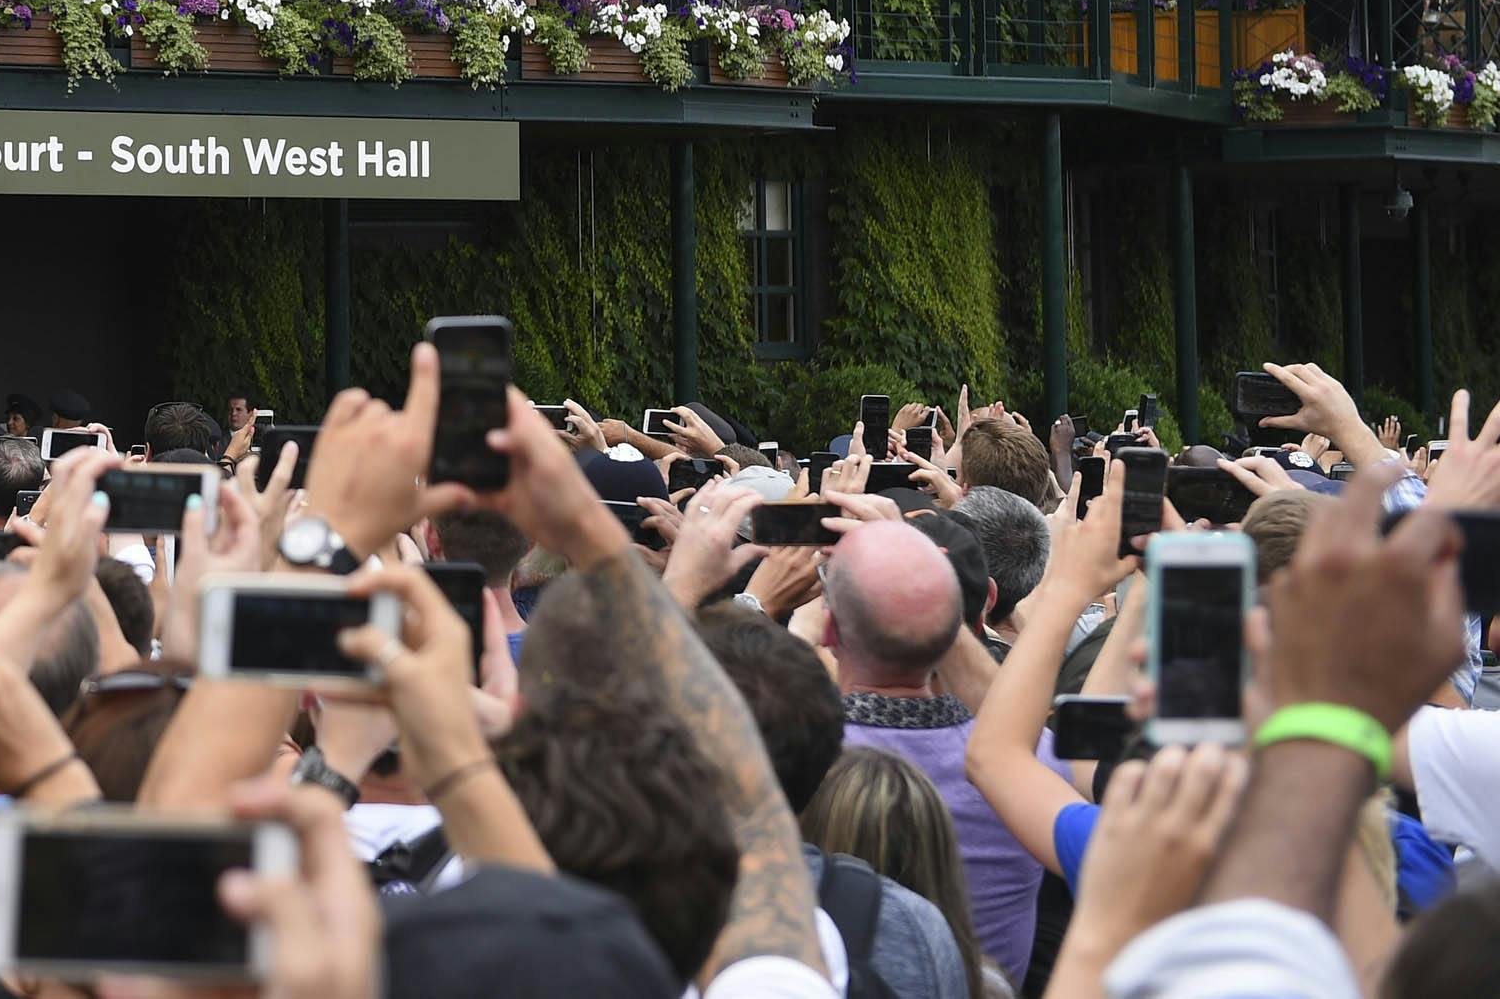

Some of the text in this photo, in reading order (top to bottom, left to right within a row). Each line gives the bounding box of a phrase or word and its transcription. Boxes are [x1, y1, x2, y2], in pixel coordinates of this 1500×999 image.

[77, 150, 93, 161] -
[110, 135, 230, 175] South
[242, 137, 344, 177] West
[358, 140, 430, 178] Hall
